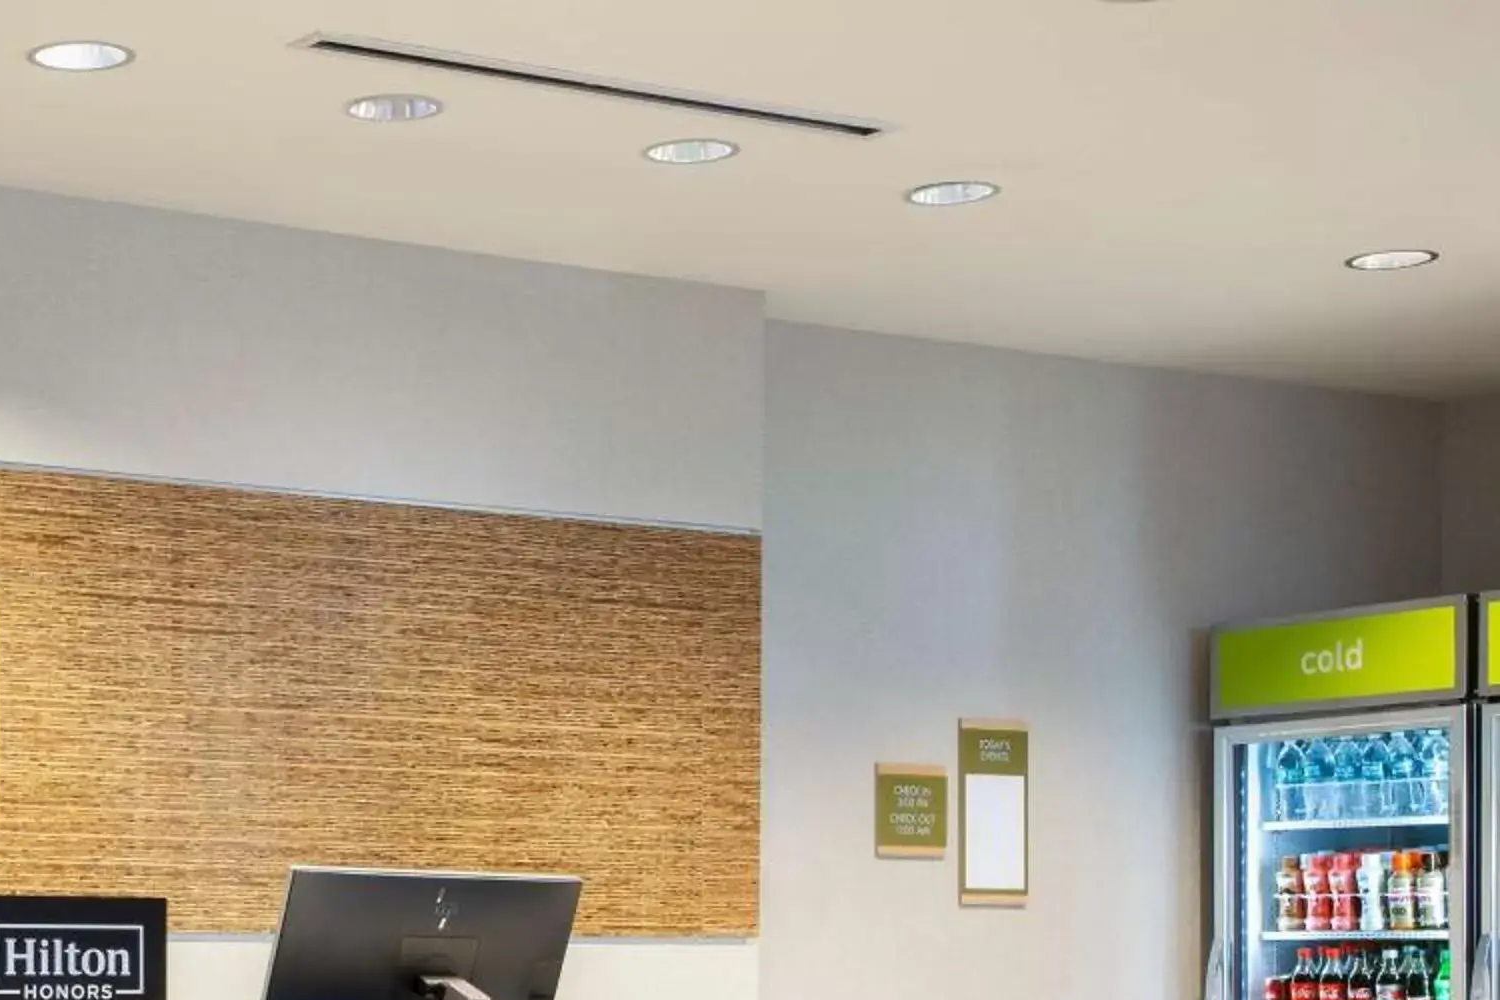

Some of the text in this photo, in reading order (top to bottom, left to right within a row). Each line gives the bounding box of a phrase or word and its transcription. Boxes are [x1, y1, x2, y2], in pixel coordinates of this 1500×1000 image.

[1300, 638, 1364, 675] cold
[4, 938, 131, 977] Hilton
[23, 984, 113, 1000] HONORS
